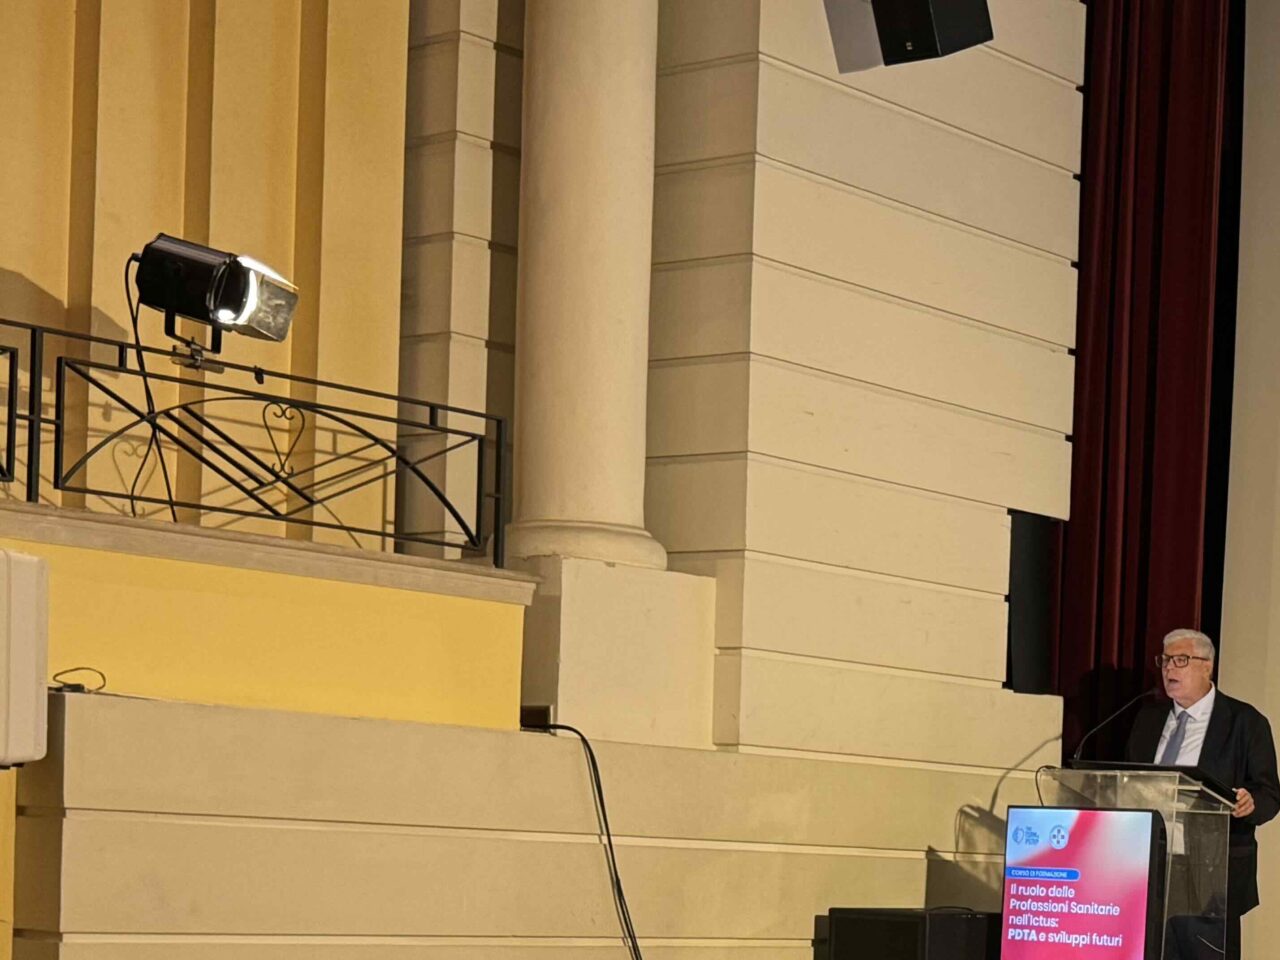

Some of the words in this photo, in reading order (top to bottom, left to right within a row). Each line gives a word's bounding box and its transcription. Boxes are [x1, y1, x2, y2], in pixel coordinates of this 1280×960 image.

[1010, 883, 1017, 895] Il
[1018, 884, 1046, 896] ruolo
[1048, 885, 1075, 897] delle
[1009, 898, 1069, 913] Professioni
[1070, 901, 1121, 916] Sanitarie
[1007, 928, 1038, 941] PDTA
[1039, 932, 1046, 941] e
[1048, 931, 1090, 947] sviluppi
[1092, 933, 1123, 947] futuri
